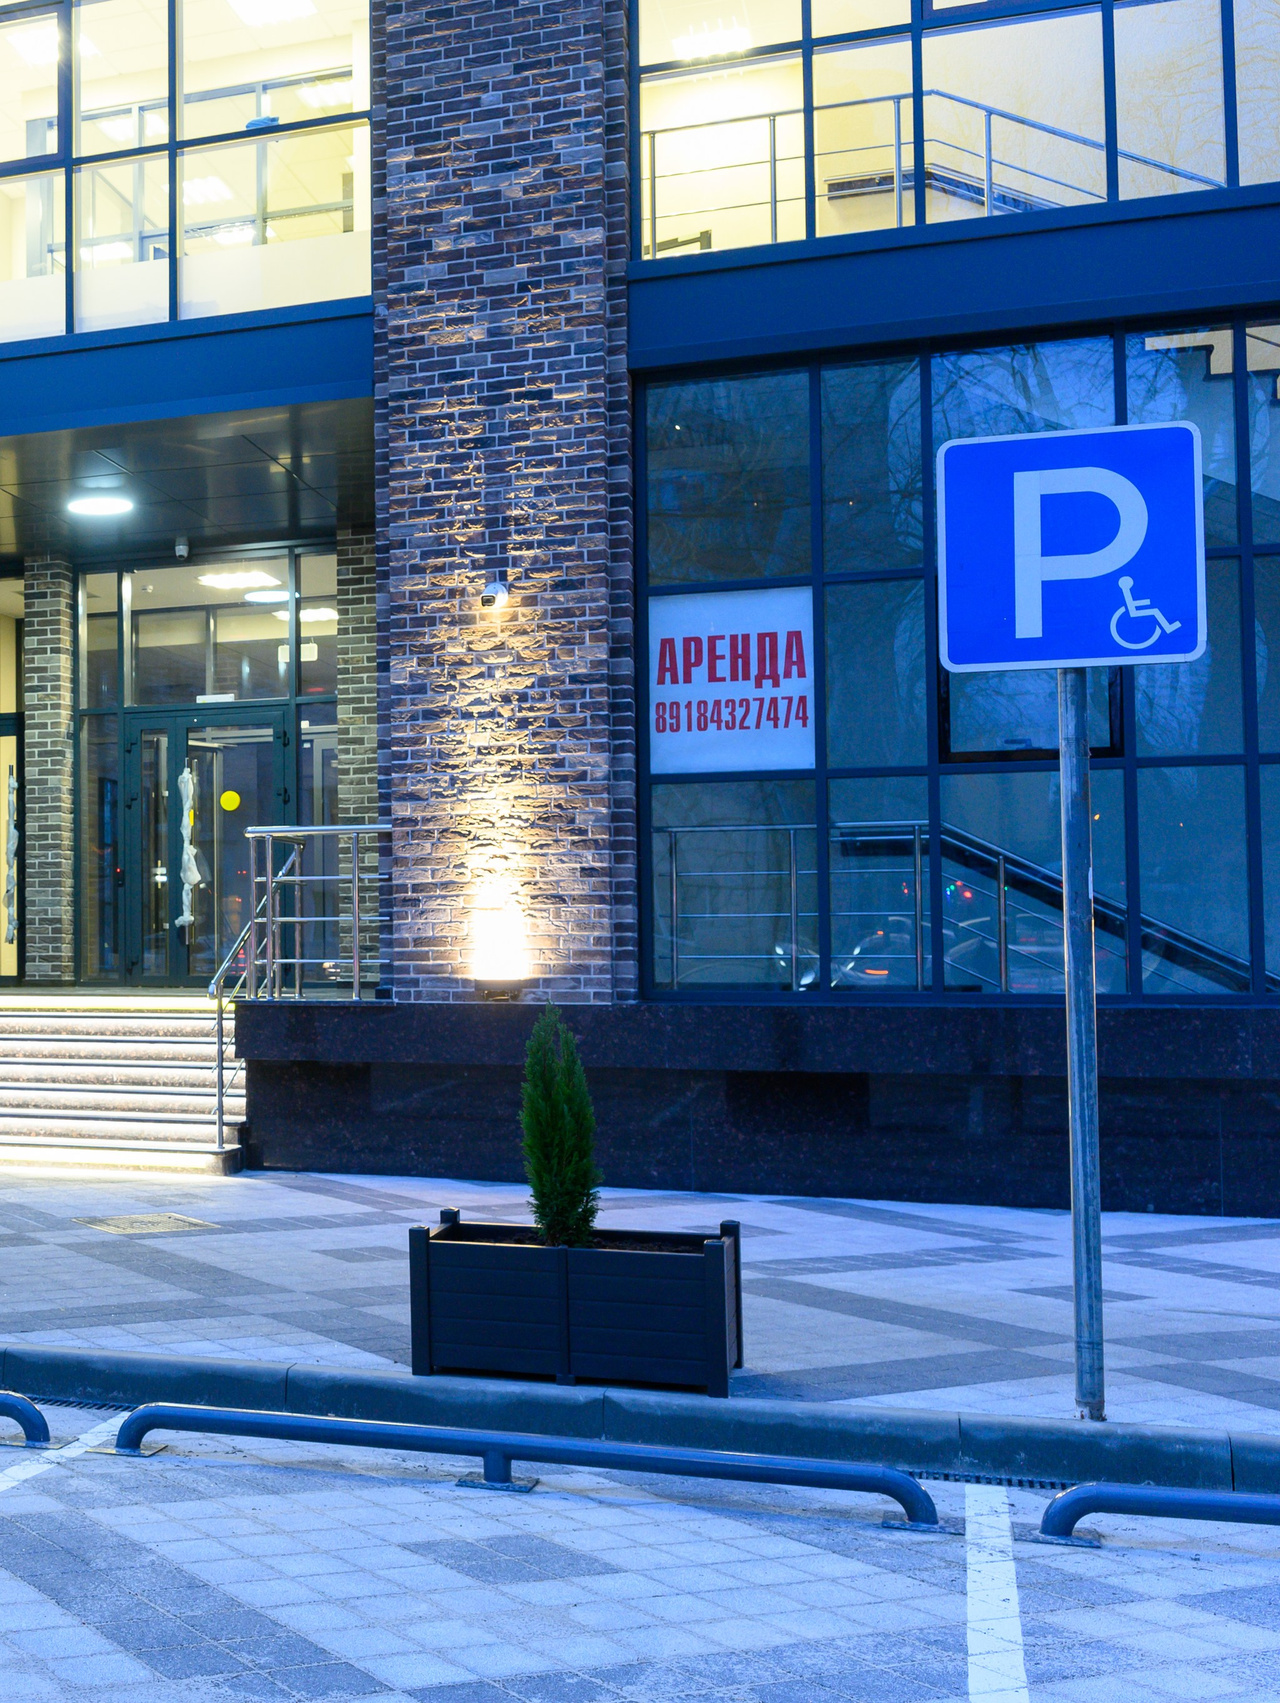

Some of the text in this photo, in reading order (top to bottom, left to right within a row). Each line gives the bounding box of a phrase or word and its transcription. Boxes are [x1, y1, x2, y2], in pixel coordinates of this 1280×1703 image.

[1014, 466, 1148, 639] P
[656, 630, 807, 689] АРЕНДА
[655, 695, 809, 733] 89184327474
